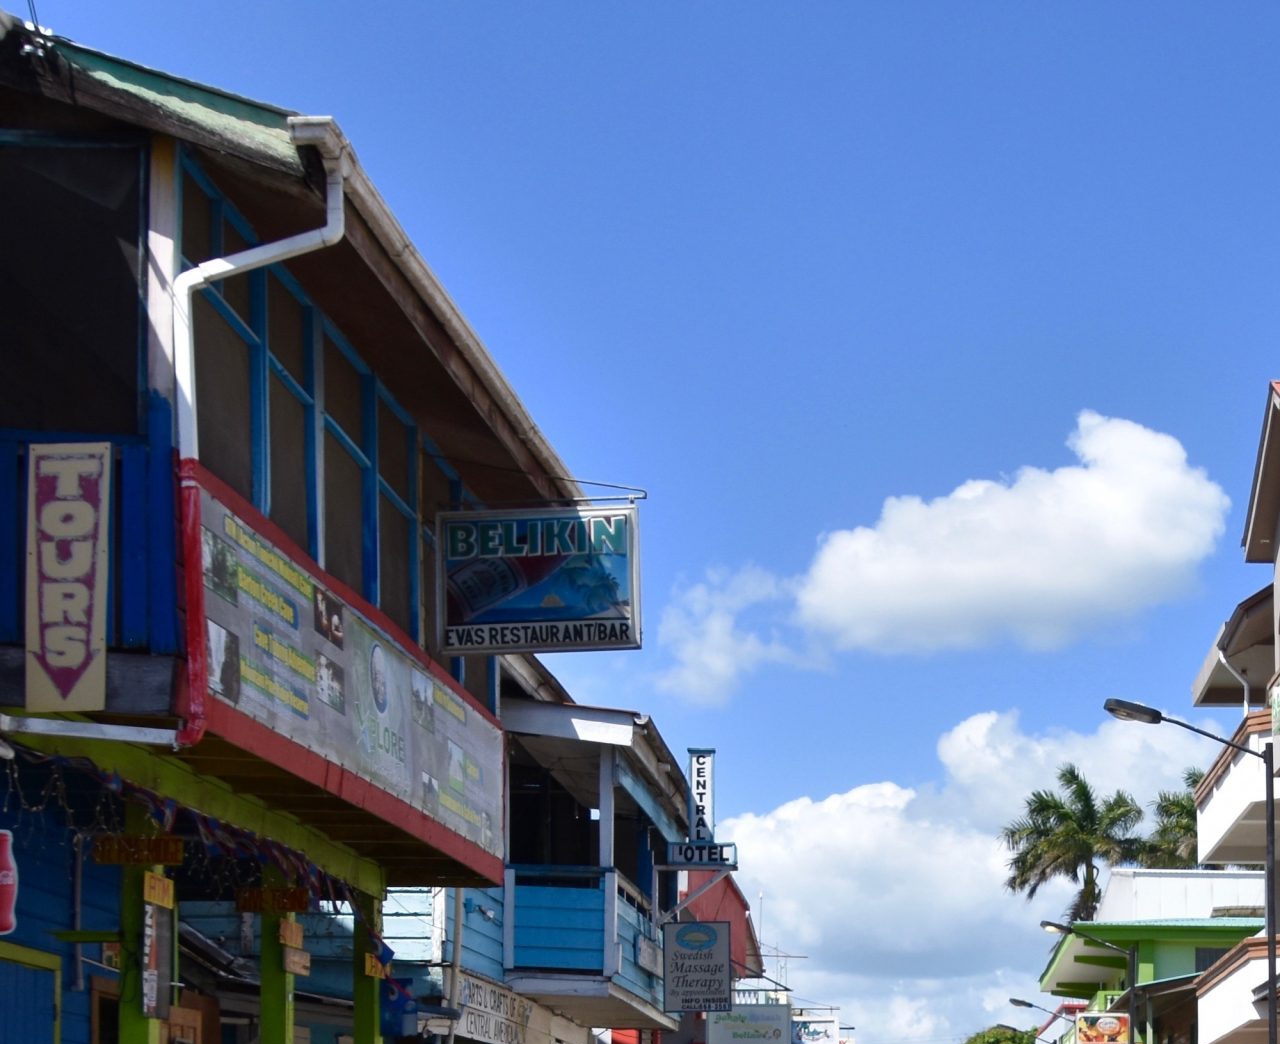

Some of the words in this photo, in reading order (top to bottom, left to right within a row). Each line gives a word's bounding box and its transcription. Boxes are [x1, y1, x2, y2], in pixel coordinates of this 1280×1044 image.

[447, 516, 628, 560] BELIKIN
[39, 455, 102, 668] TOURS
[446, 626, 486, 647] EVA'S
[489, 621, 630, 645] RESTAURANT/BAR
[695, 754, 707, 841] CENTRAL
[672, 949, 714, 961] Swedish
[670, 962, 725, 977] Massage
[671, 974, 724, 990] Therapy
[466, 1011, 492, 1042] CENTRAL
